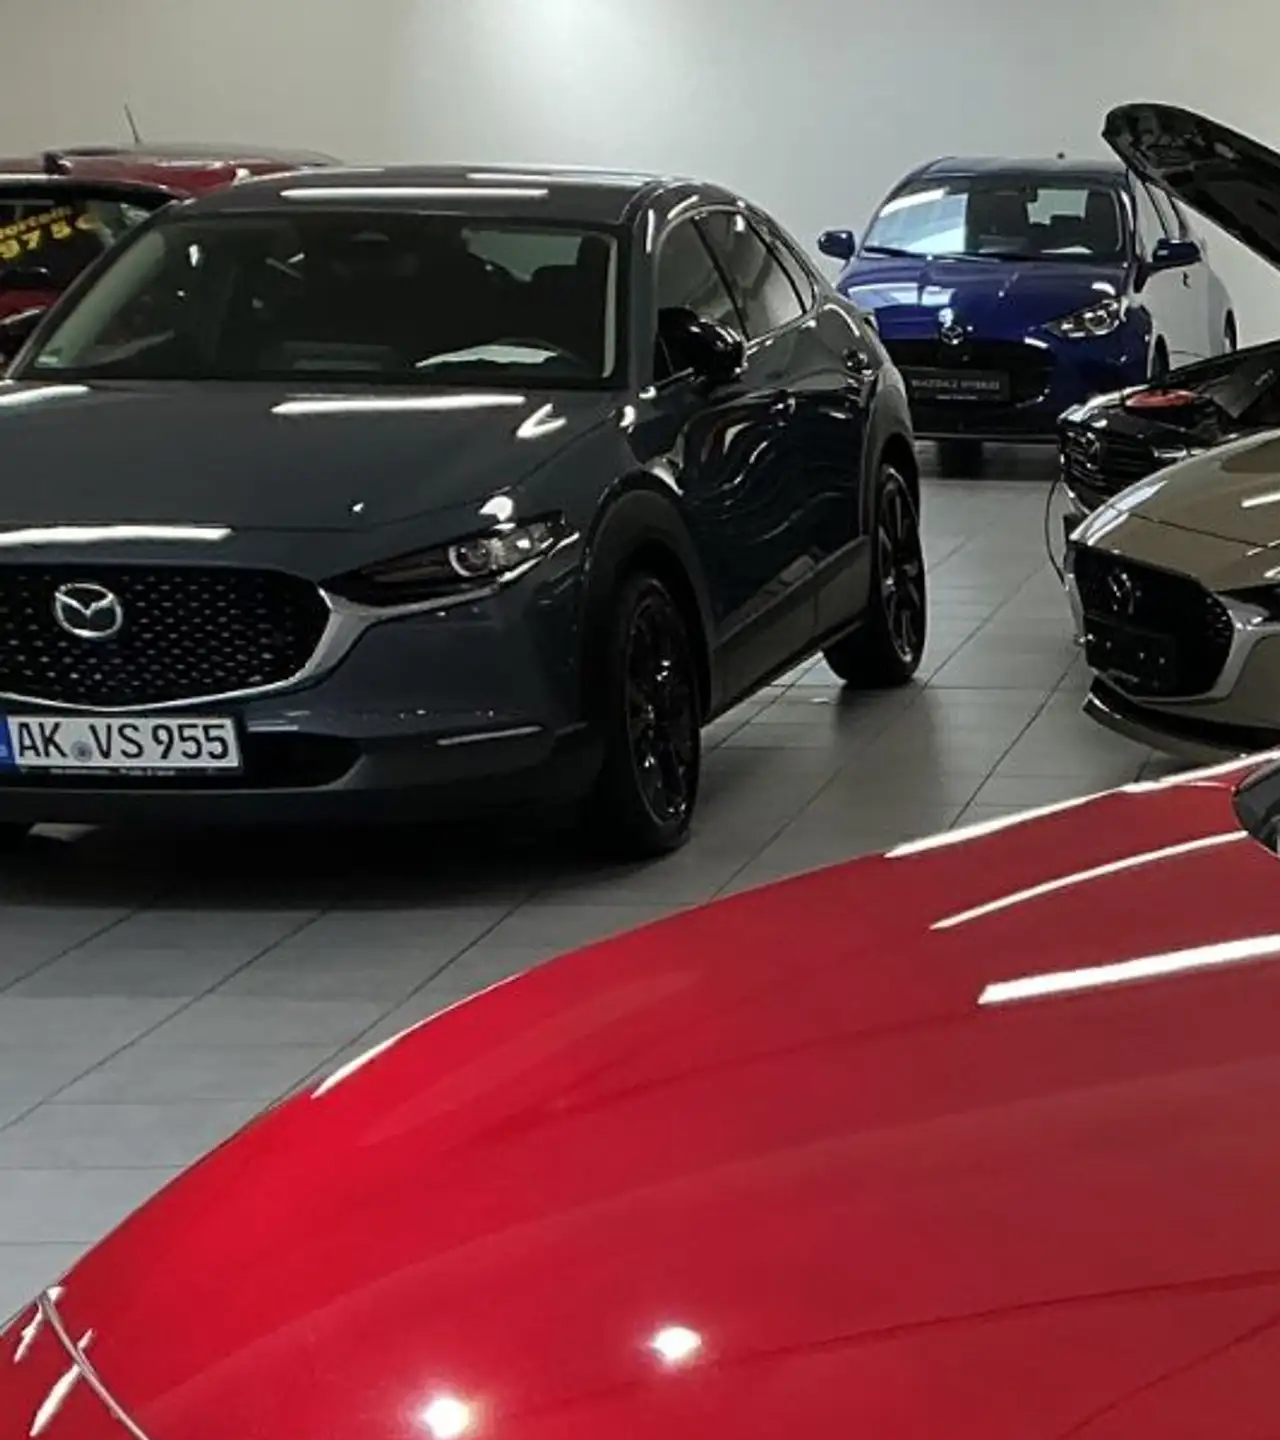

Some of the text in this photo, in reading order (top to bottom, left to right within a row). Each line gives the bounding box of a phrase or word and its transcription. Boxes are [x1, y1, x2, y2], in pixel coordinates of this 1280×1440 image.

[18, 721, 230, 761] AK VS 955
